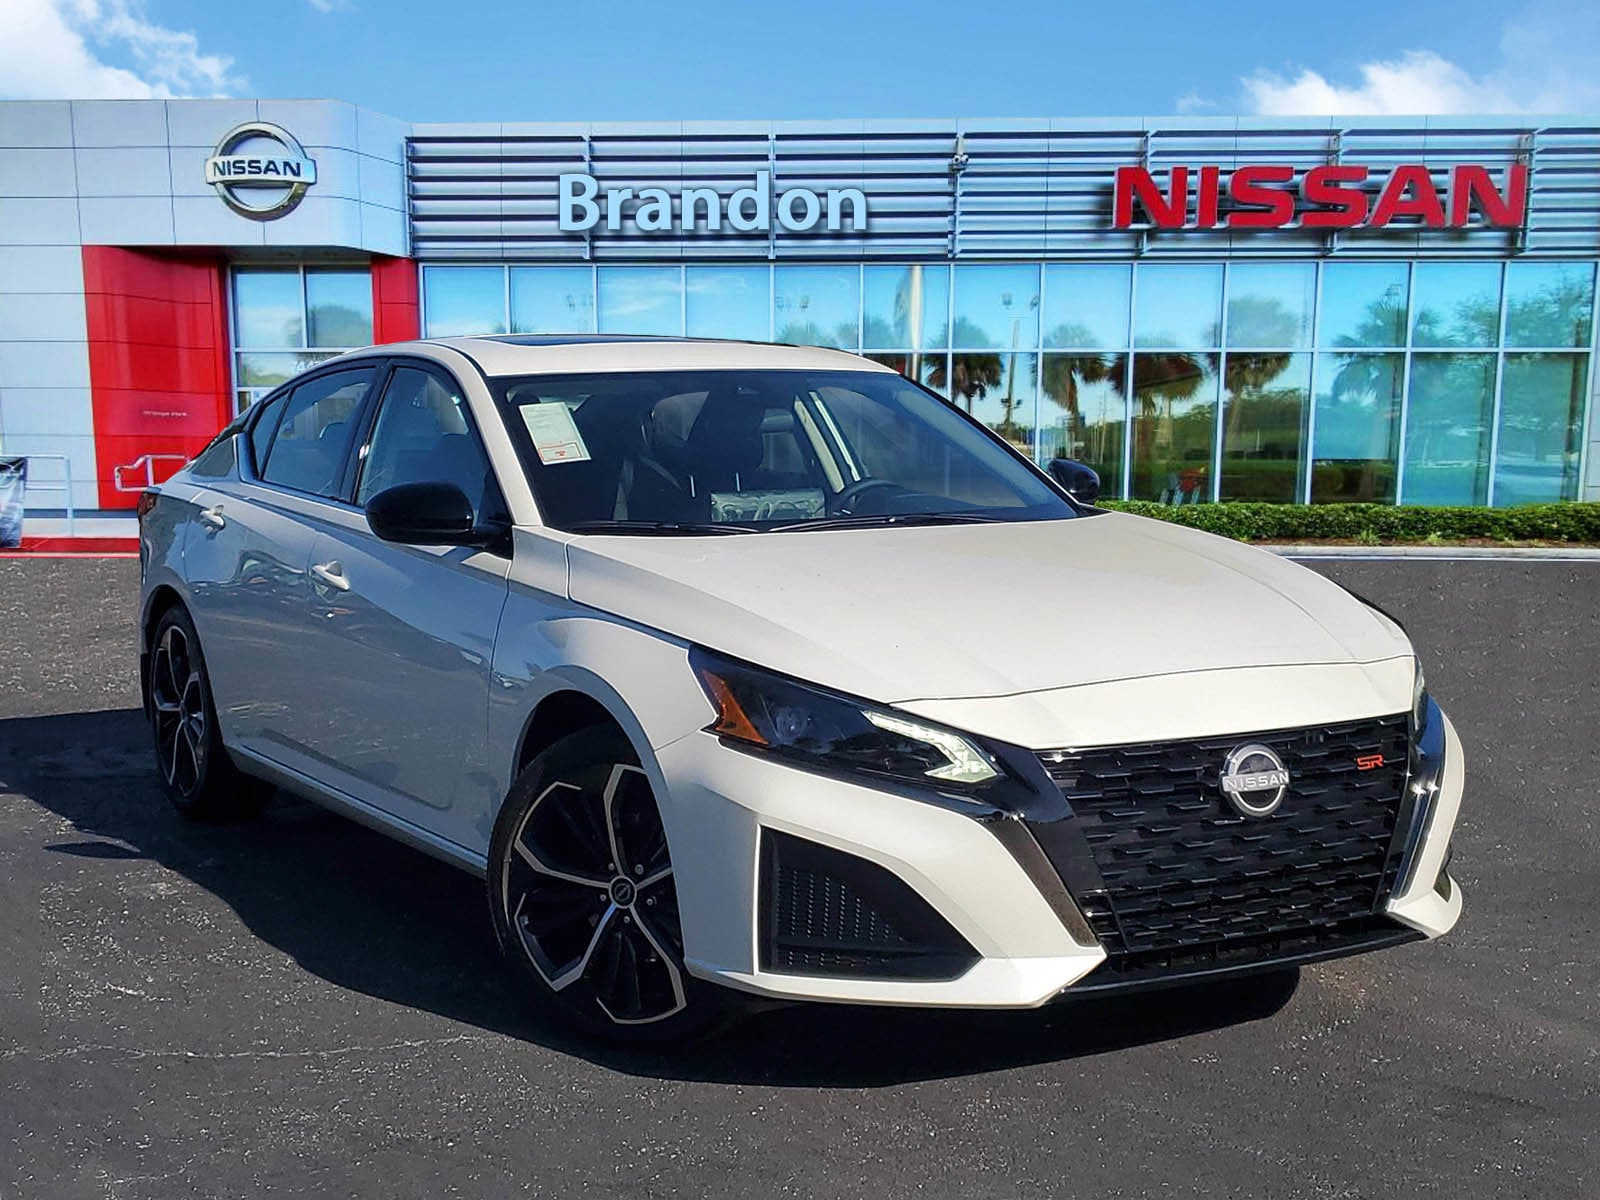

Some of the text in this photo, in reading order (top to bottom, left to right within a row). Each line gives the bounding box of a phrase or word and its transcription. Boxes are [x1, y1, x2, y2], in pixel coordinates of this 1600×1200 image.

[213, 160, 301, 177] NISSAN
[559, 170, 867, 231] Brandon
[1114, 165, 1528, 229] NISSAN
[1357, 755, 1384, 770] SR
[1226, 772, 1289, 790] NISSAN
